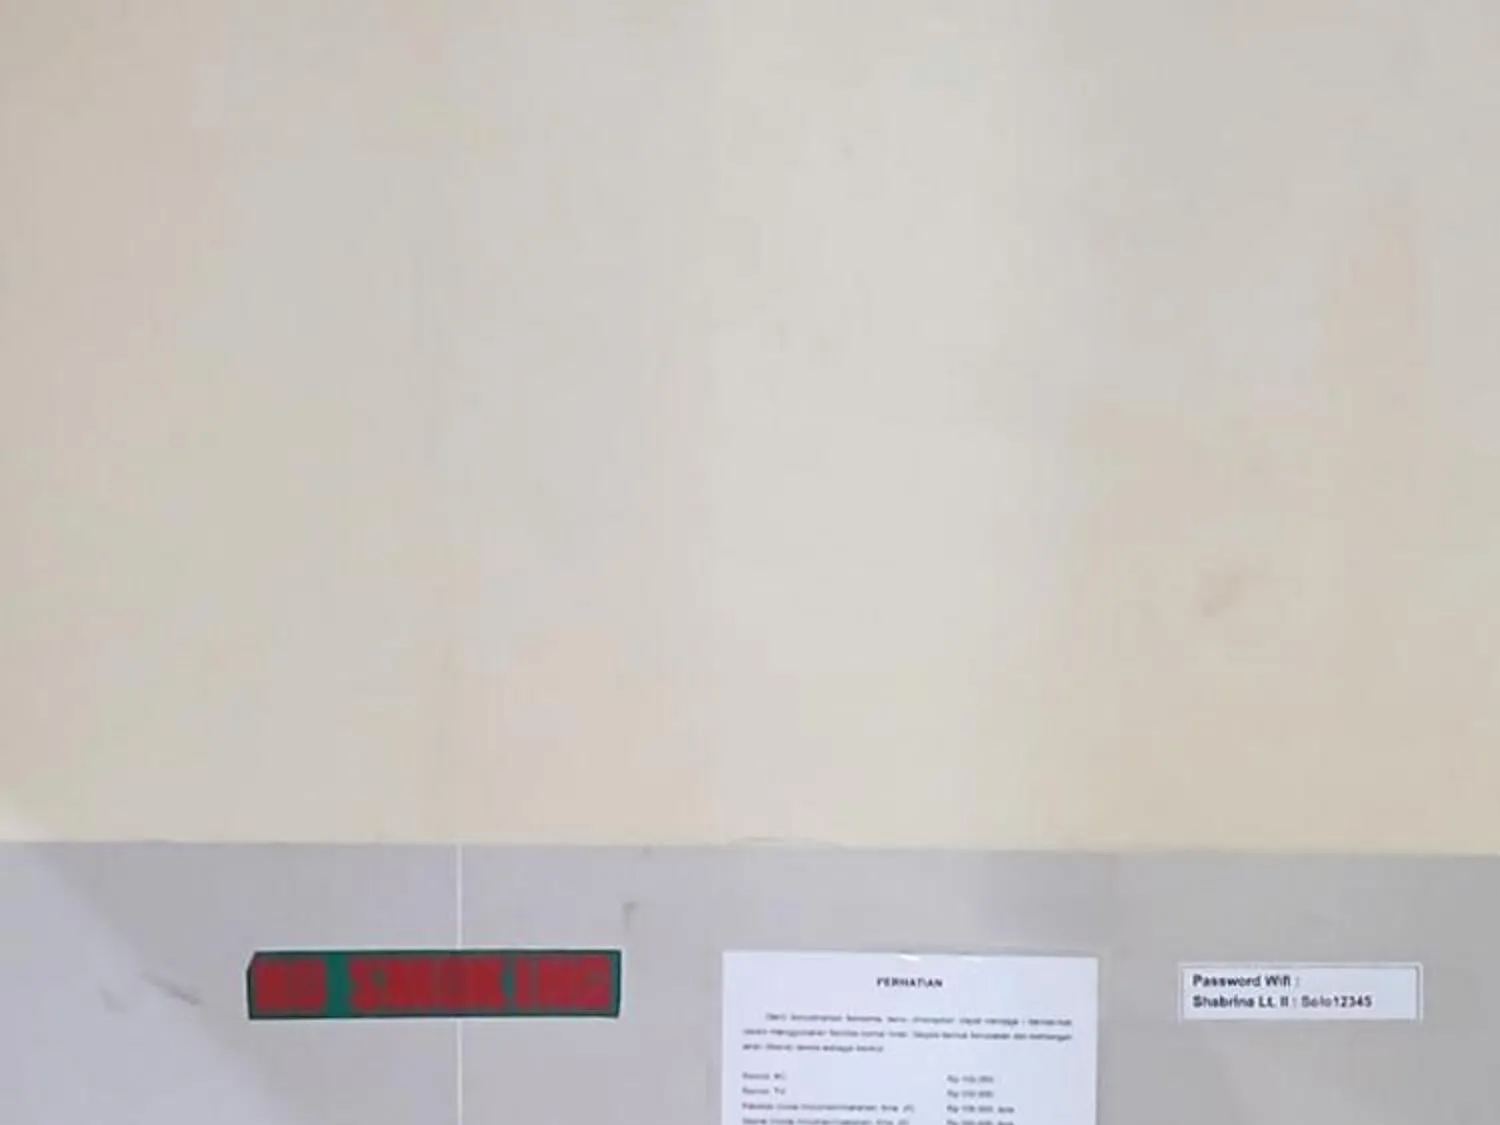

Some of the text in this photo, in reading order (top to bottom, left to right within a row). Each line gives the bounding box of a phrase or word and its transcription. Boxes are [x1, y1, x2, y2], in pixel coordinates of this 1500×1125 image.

[1192, 973, 1261, 987] Password
[1265, 975, 1291, 988] Wifi
[1192, 994, 1255, 1008] Shabrina
[1301, 995, 1373, 1008] Solo12345
